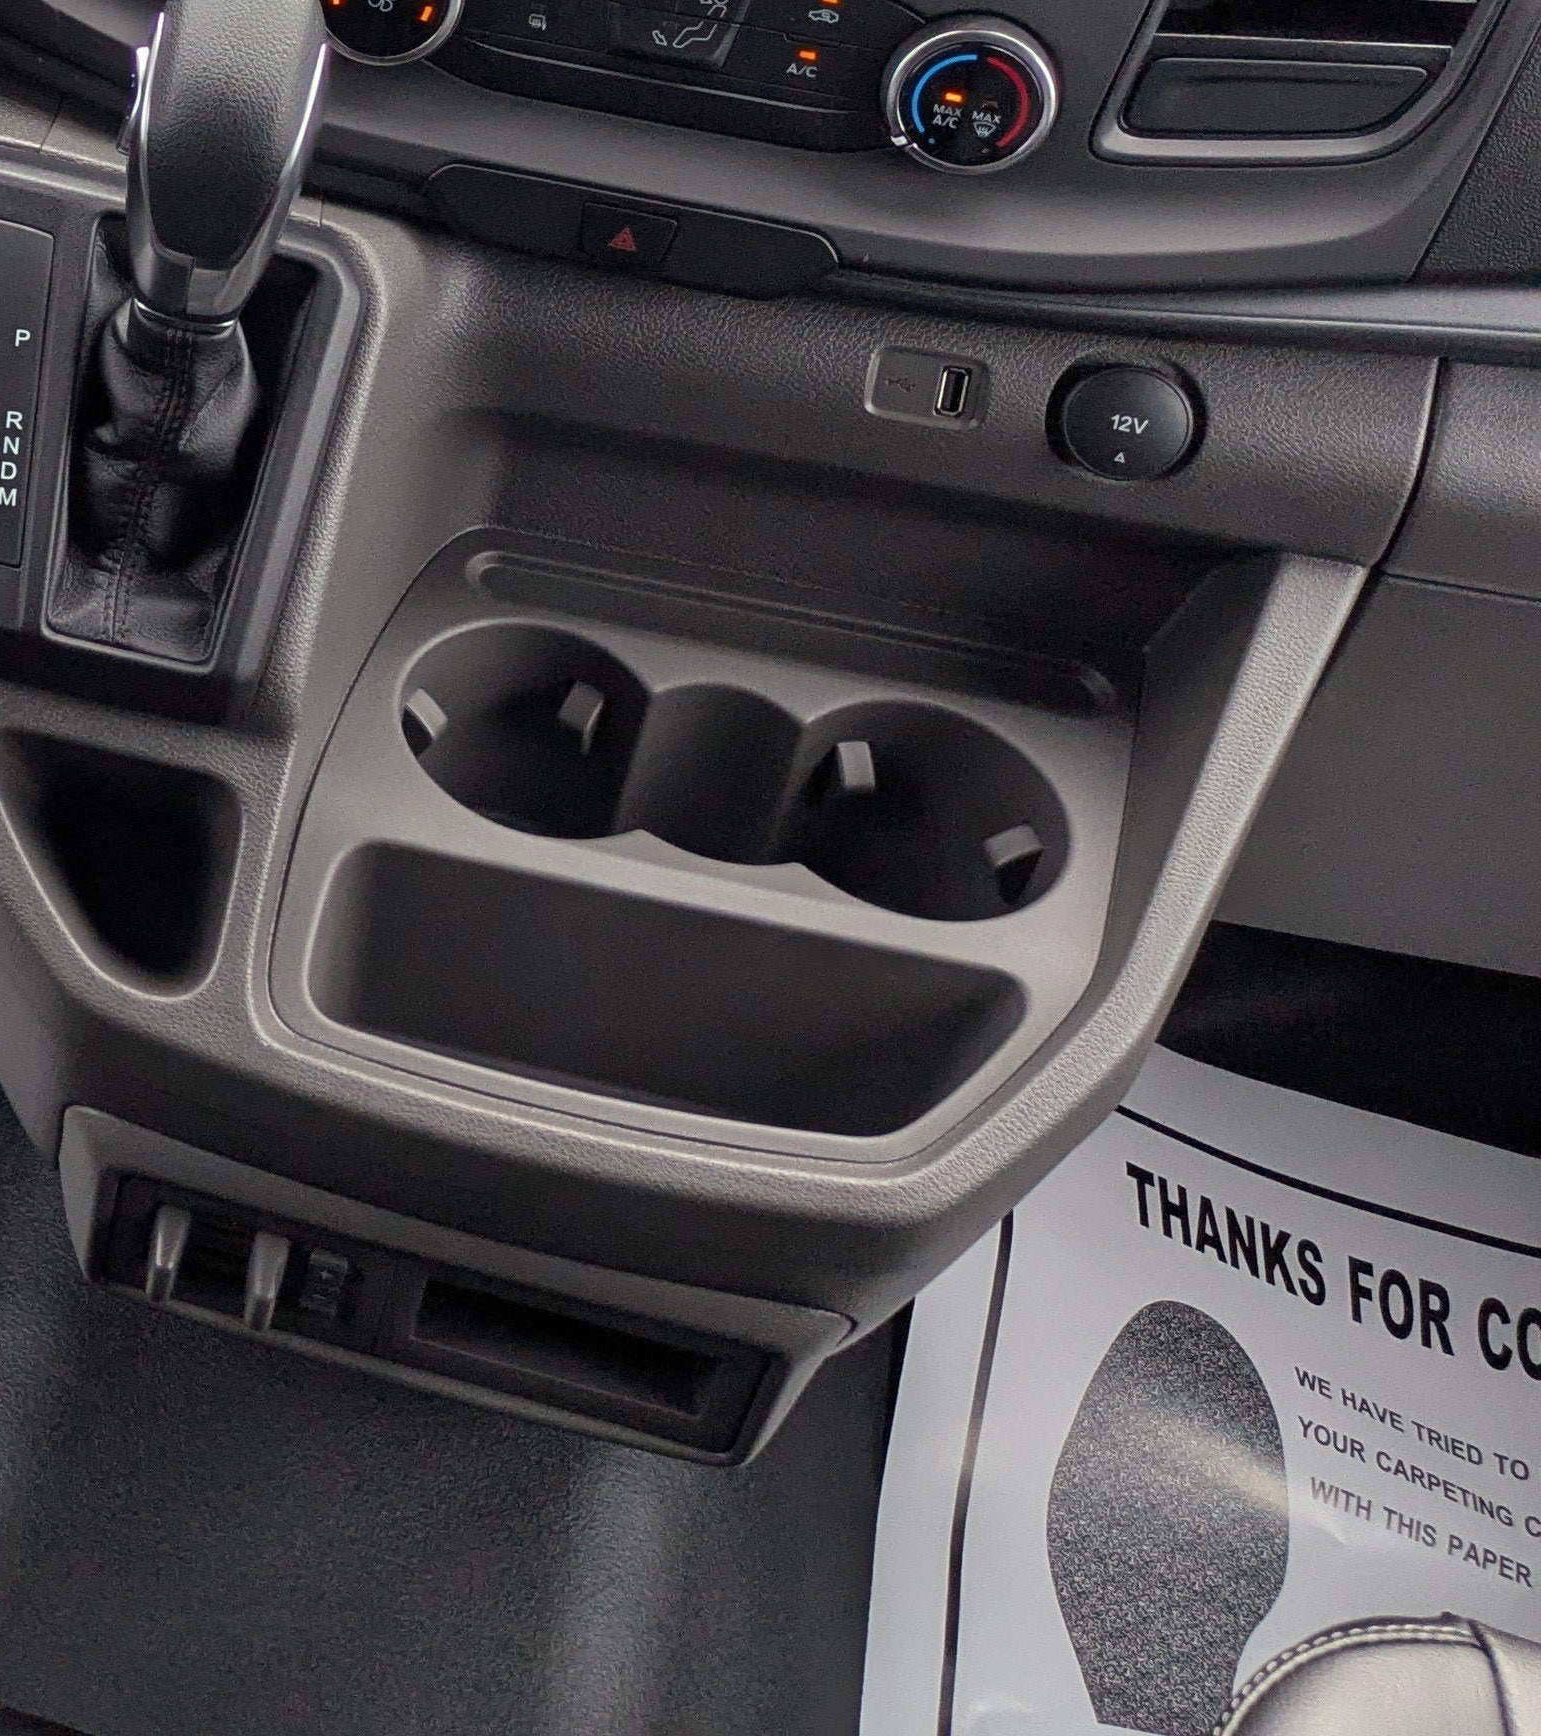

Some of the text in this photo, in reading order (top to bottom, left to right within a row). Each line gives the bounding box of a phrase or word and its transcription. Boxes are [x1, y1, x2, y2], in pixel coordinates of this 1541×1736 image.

[786, 60, 817, 79] A/C
[933, 102, 962, 118] MAX
[972, 110, 1001, 124] MAX
[932, 113, 959, 129] A/C
[14, 329, 31, 347] P
[6, 411, 22, 430] R
[1111, 414, 1149, 435] 12V
[2, 436, 19, 455] N
[0, 461, 17, 480] D
[1125, 1162, 1325, 1305] THANKS
[1348, 1256, 1455, 1357] FOR
[1294, 1366, 1530, 1480] WE HAVE TRIED TO
[1298, 1416, 1366, 1461] YOUR
[1375, 1451, 1514, 1528] CARPETING
[1310, 1477, 1532, 1586] WITH THIS PAPER
